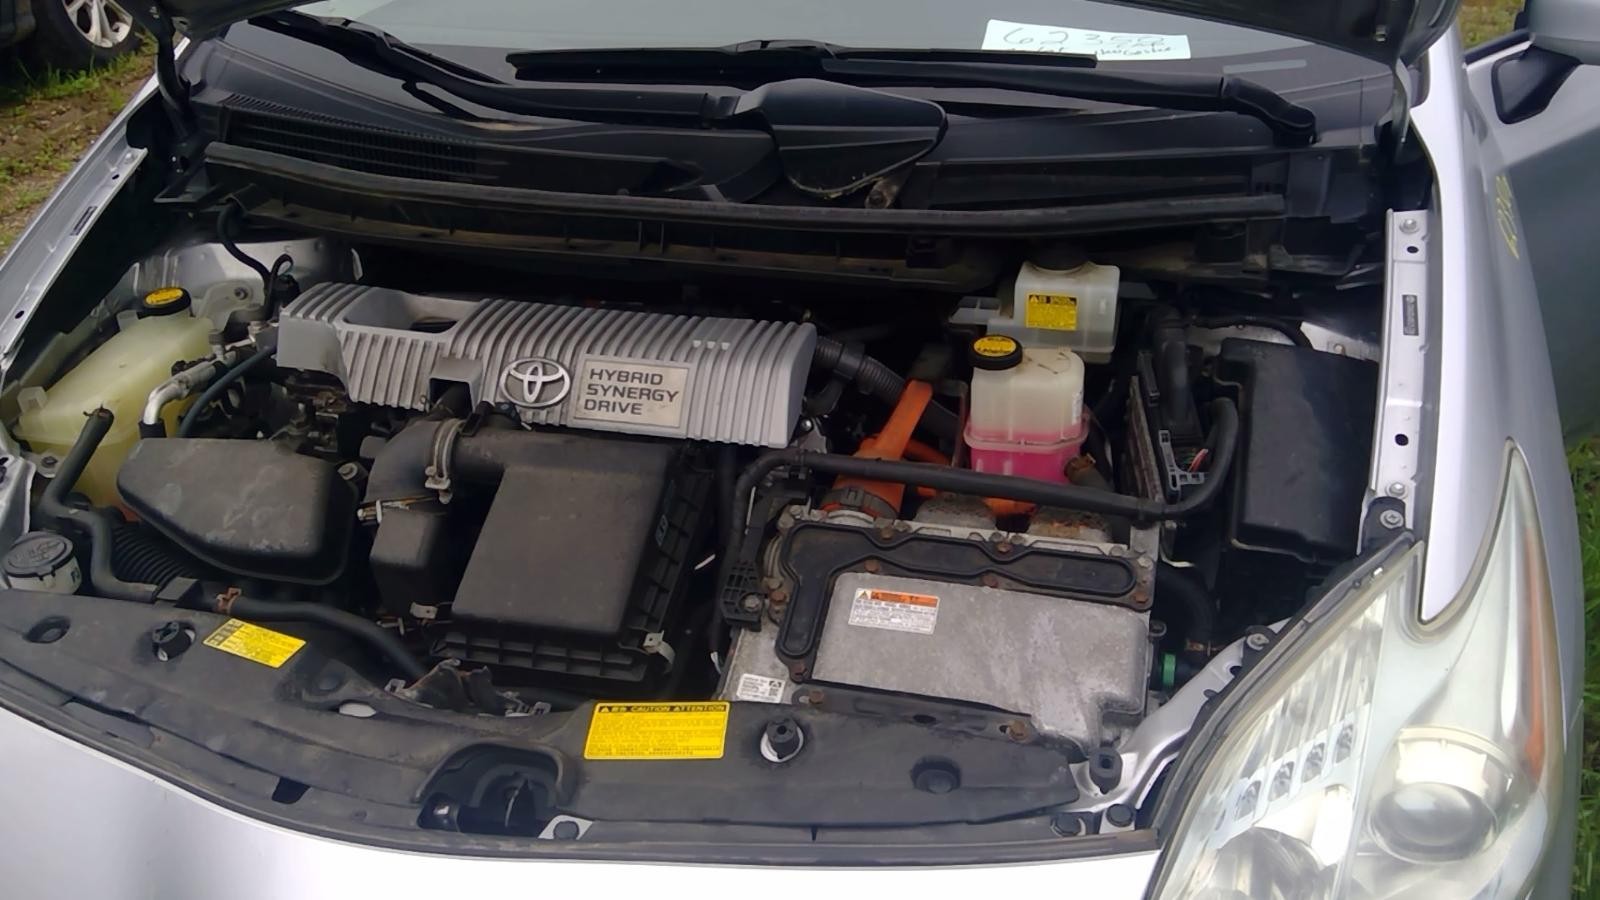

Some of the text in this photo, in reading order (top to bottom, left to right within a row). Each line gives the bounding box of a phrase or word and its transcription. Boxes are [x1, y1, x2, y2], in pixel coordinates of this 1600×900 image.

[589, 368, 664, 386] HYBRID
[586, 383, 680, 403] SYNERGY
[583, 399, 644, 416] DRIVE
[673, 704, 726, 712] ATTENTION
